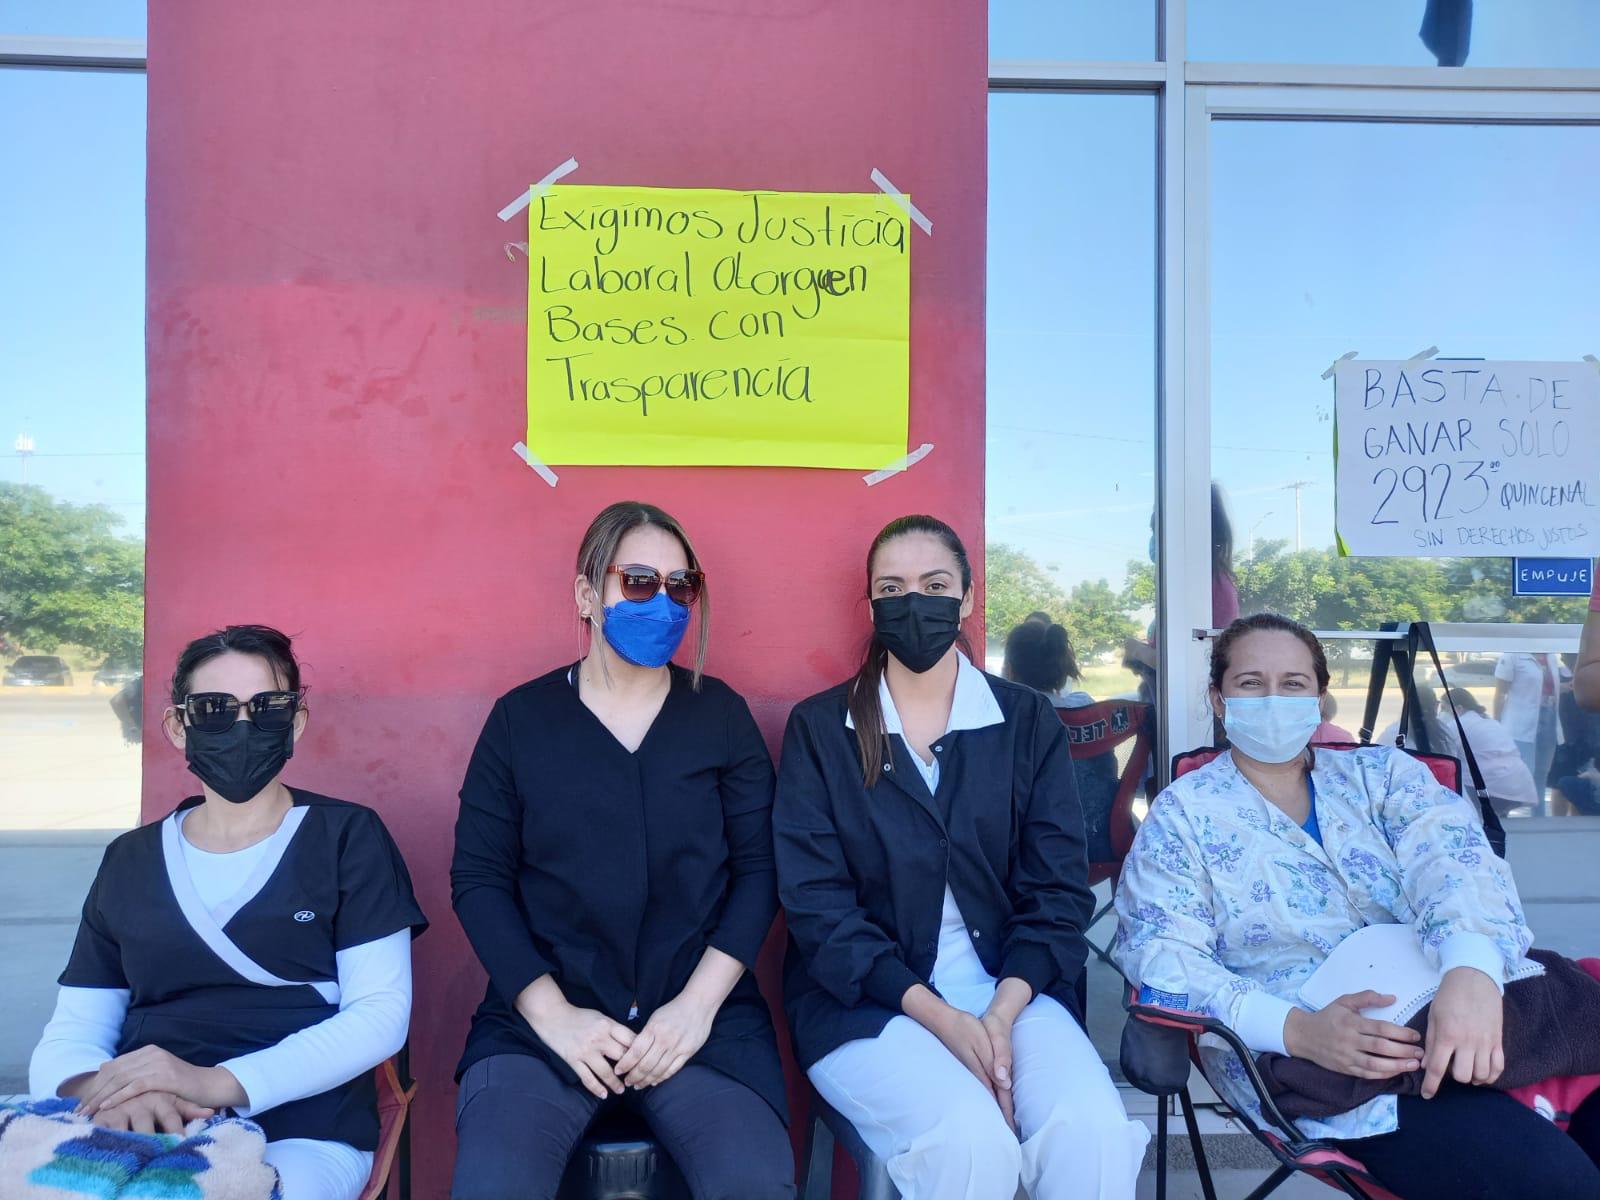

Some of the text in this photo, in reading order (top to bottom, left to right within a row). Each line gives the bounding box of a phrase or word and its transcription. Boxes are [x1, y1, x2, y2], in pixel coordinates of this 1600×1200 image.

[539, 193, 905, 255] Exigimos Justicia
[541, 251, 692, 297] Laboral
[546, 352, 814, 417] Trasparencia
[1528, 376, 1572, 413] DE
[1364, 418, 1570, 459] GANAR SOLO
[1500, 480, 1597, 511] QUINCENAL
[1413, 528, 1444, 548] SIN
[1457, 526, 1535, 546] DERECHOS
[1521, 568, 1588, 583] EMPUJE
